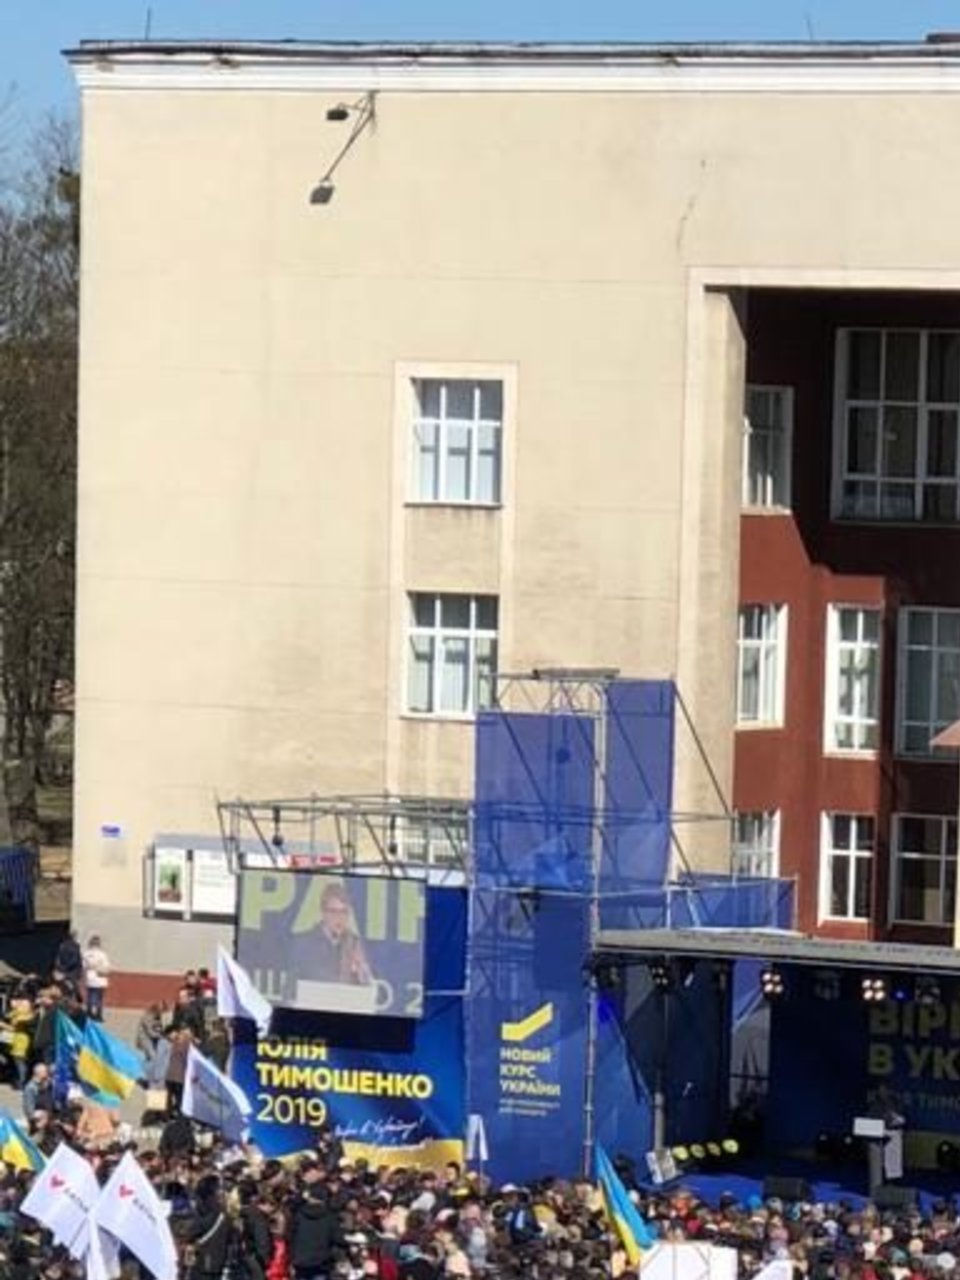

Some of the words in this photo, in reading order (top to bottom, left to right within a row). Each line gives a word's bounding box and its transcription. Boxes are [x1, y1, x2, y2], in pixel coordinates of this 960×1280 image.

[500, 1047, 552, 1063] НОВИЙ
[868, 1043, 894, 1075] В
[255, 1062, 433, 1098] ТИМОШЕНКО
[499, 1064, 537, 1079] КУРС
[256, 1094, 327, 1127] 2019
